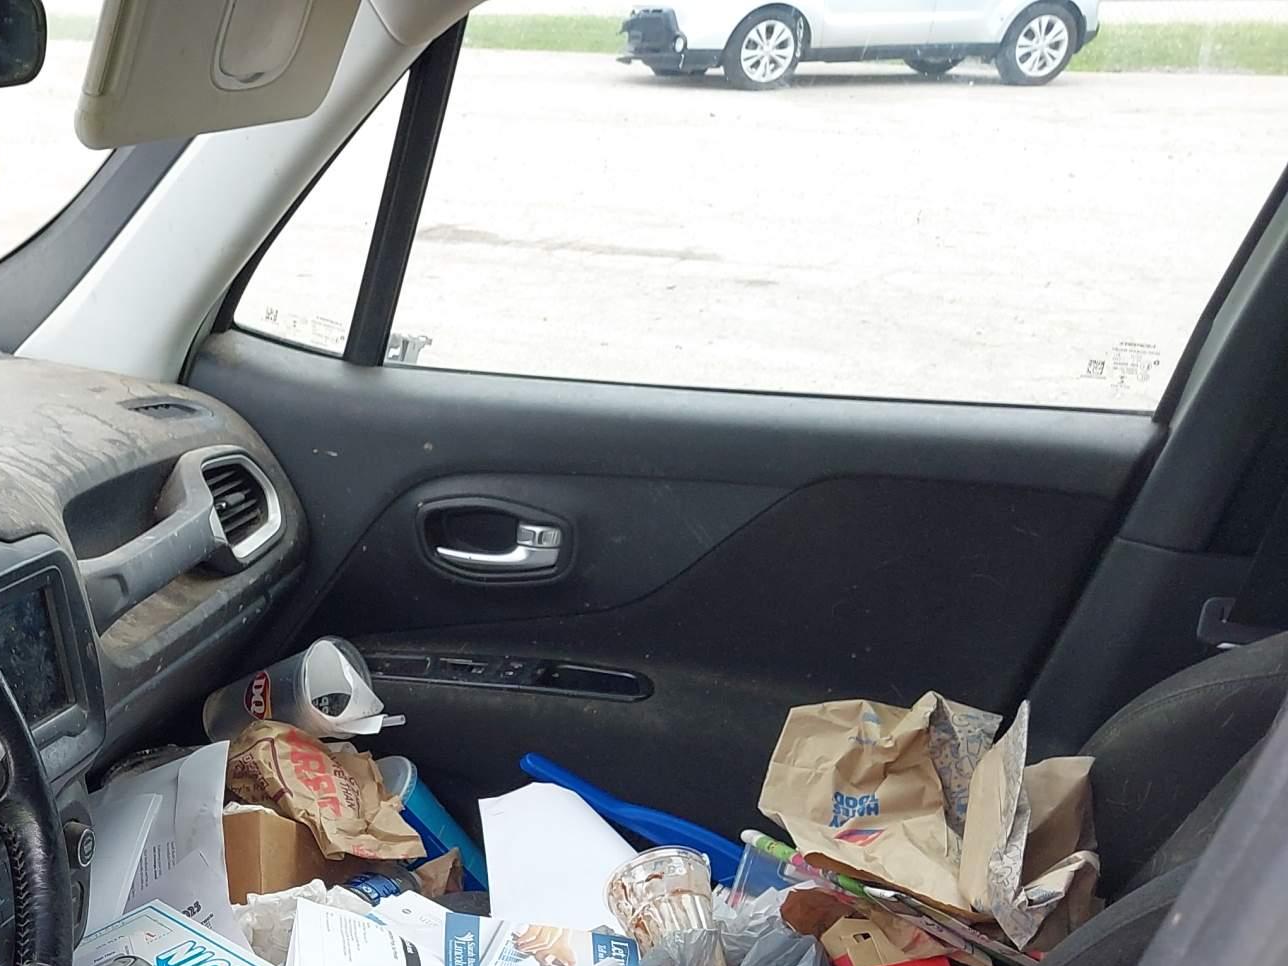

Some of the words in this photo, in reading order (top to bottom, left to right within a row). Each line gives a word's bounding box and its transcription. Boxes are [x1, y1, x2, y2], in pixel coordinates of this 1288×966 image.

[250, 677, 266, 712] DQ
[467, 940, 476, 956] Sarah
[611, 940, 628, 957] Let
